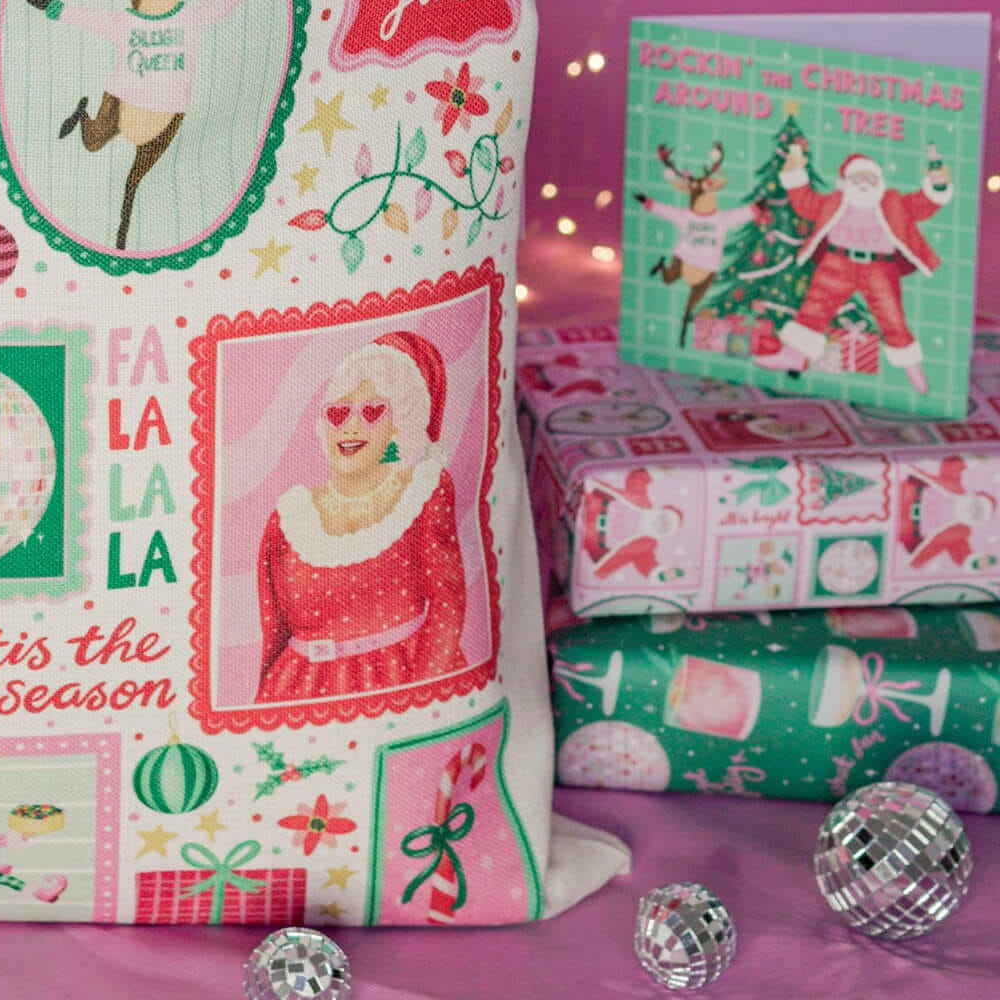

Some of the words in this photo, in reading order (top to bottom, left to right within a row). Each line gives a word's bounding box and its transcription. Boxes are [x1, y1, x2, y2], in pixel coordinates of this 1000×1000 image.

[638, 41, 753, 79] ROCKIN'
[761, 69, 792, 89] THE
[802, 63, 965, 112] CHRISTMAS
[654, 79, 773, 120] AROUND
[837, 105, 906, 141] TREE
[107, 325, 169, 387] FA
[108, 395, 172, 451] LA
[108, 461, 176, 523] LA
[107, 529, 177, 590] LA
[67, 616, 171, 667] the
